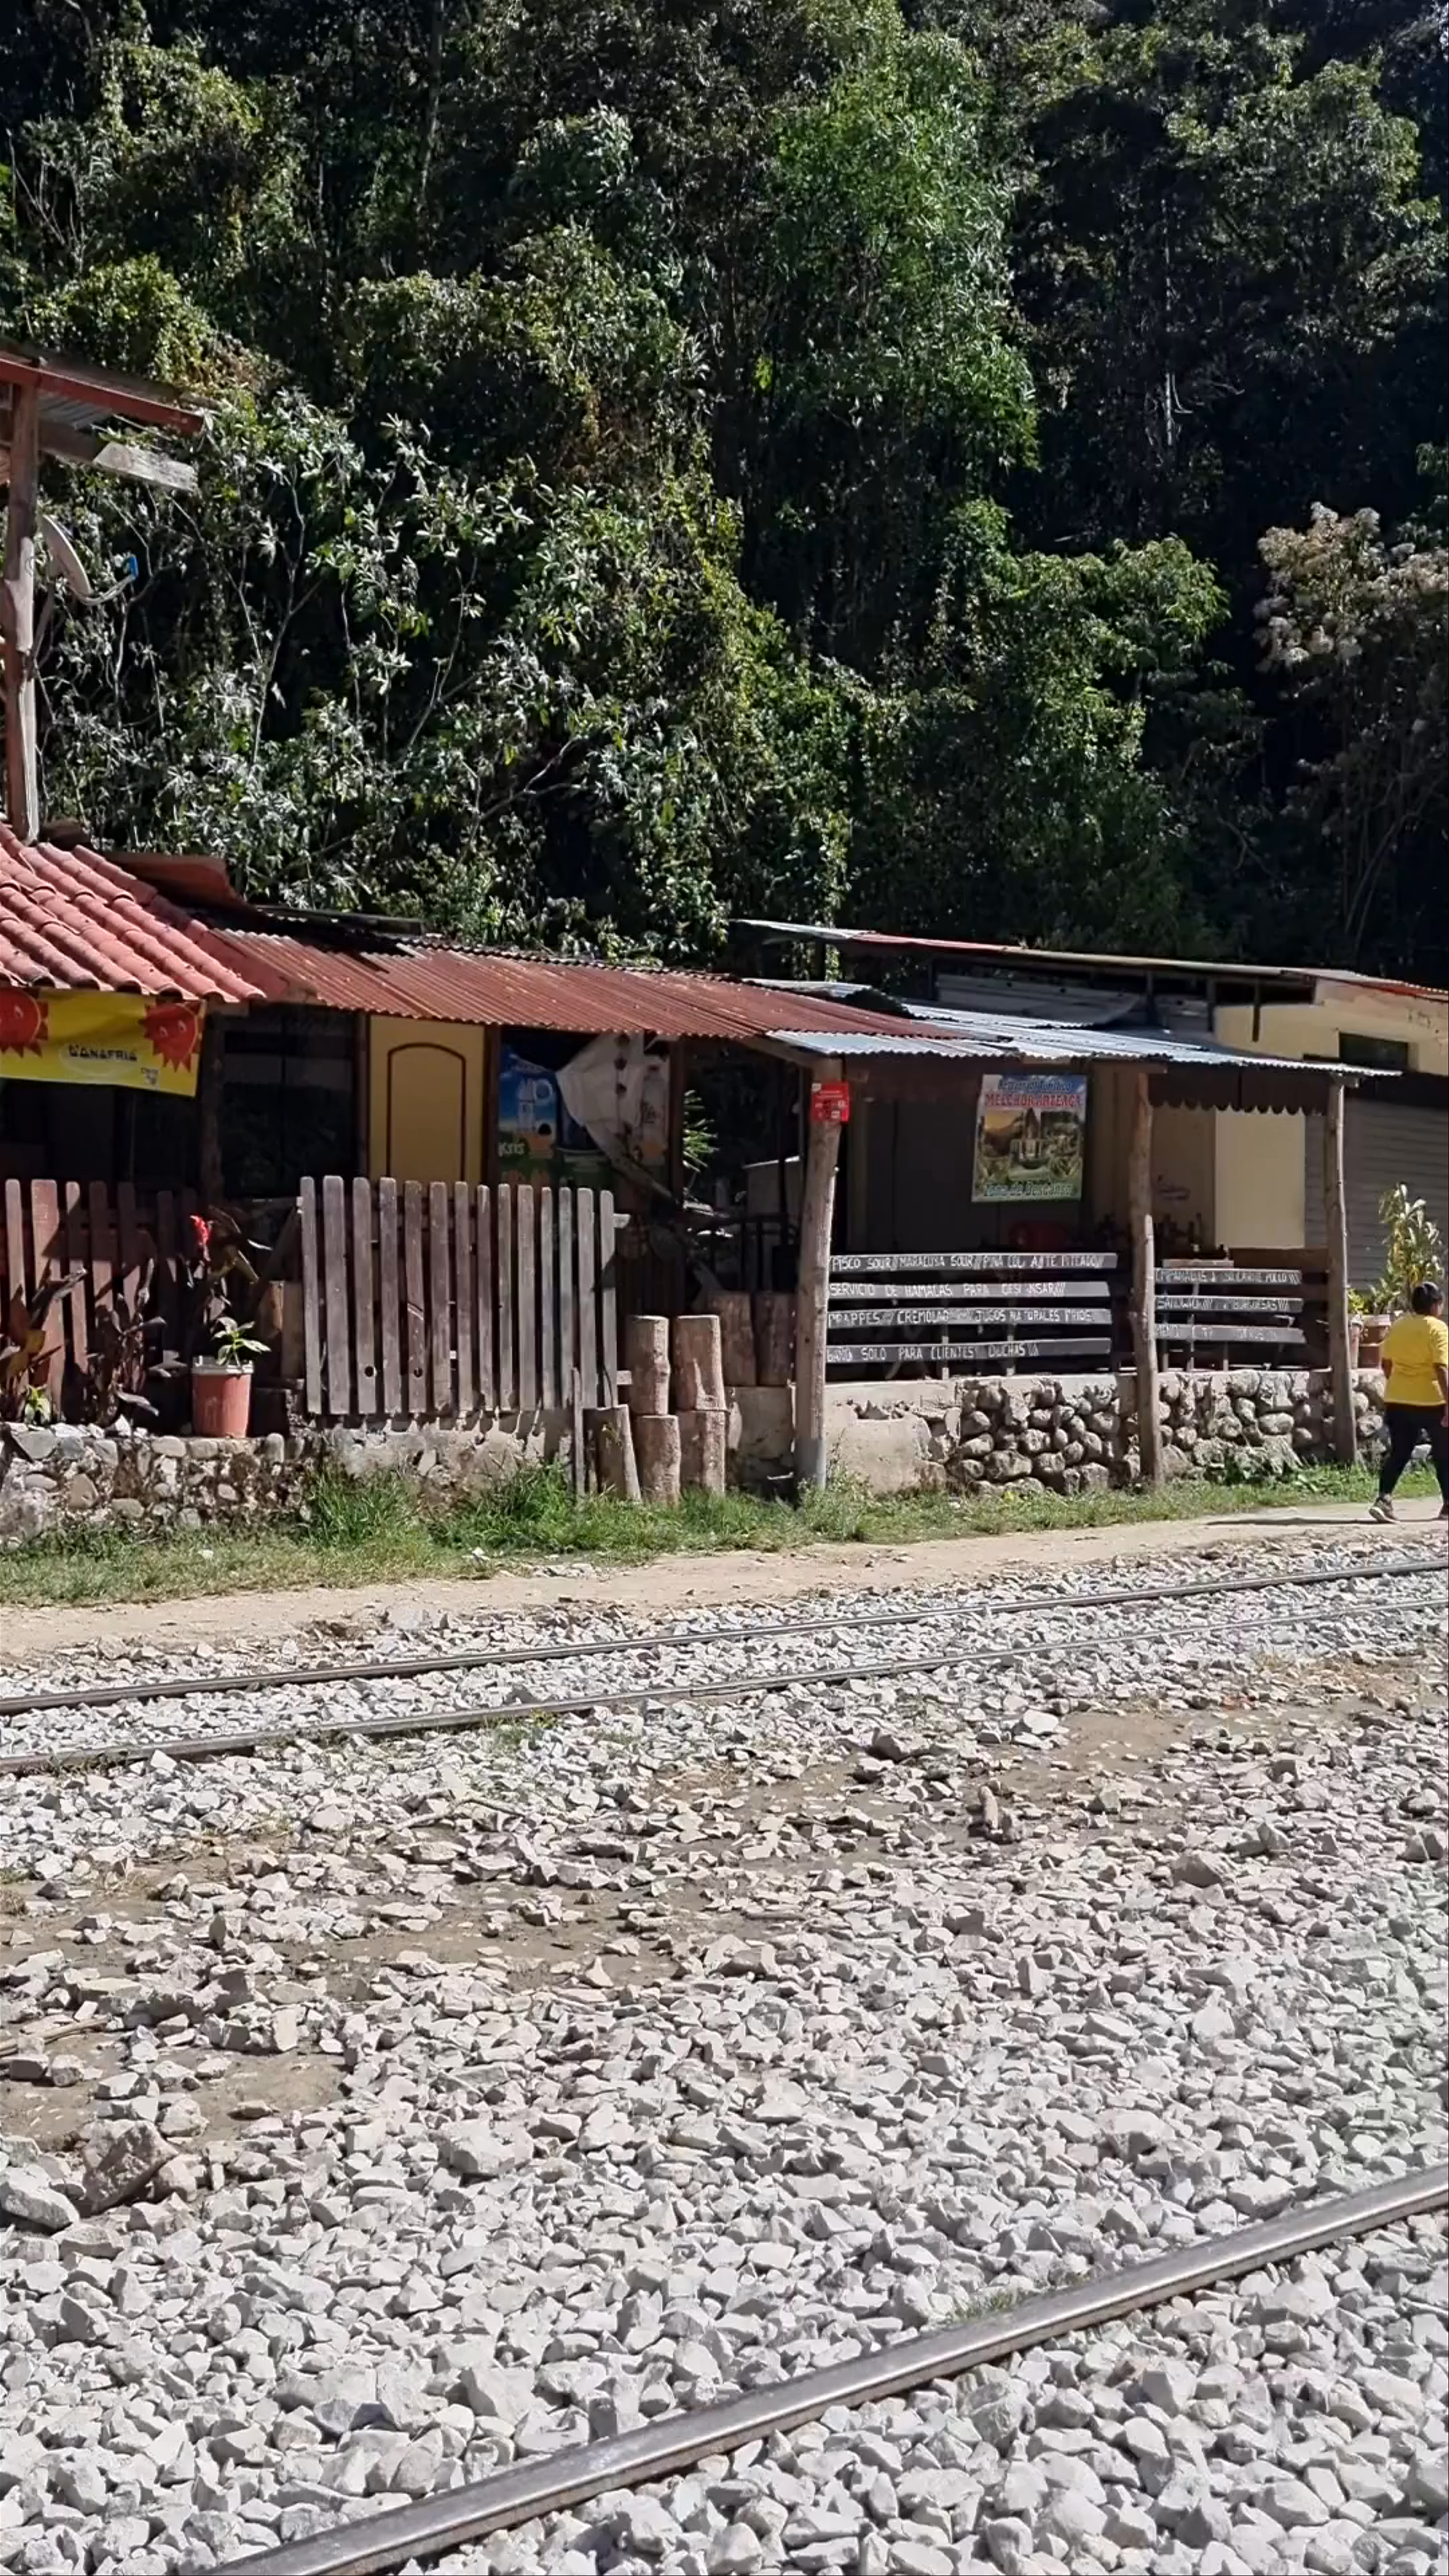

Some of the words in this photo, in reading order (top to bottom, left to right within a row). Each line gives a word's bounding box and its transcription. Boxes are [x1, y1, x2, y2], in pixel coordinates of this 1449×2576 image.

[830, 1283, 875, 1296] SERVICIO
[884, 1284, 898, 1296] DE
[963, 1284, 990, 1297] PARA
[861, 1346, 887, 1360] SOLO
[898, 1347, 923, 1360] PARA
